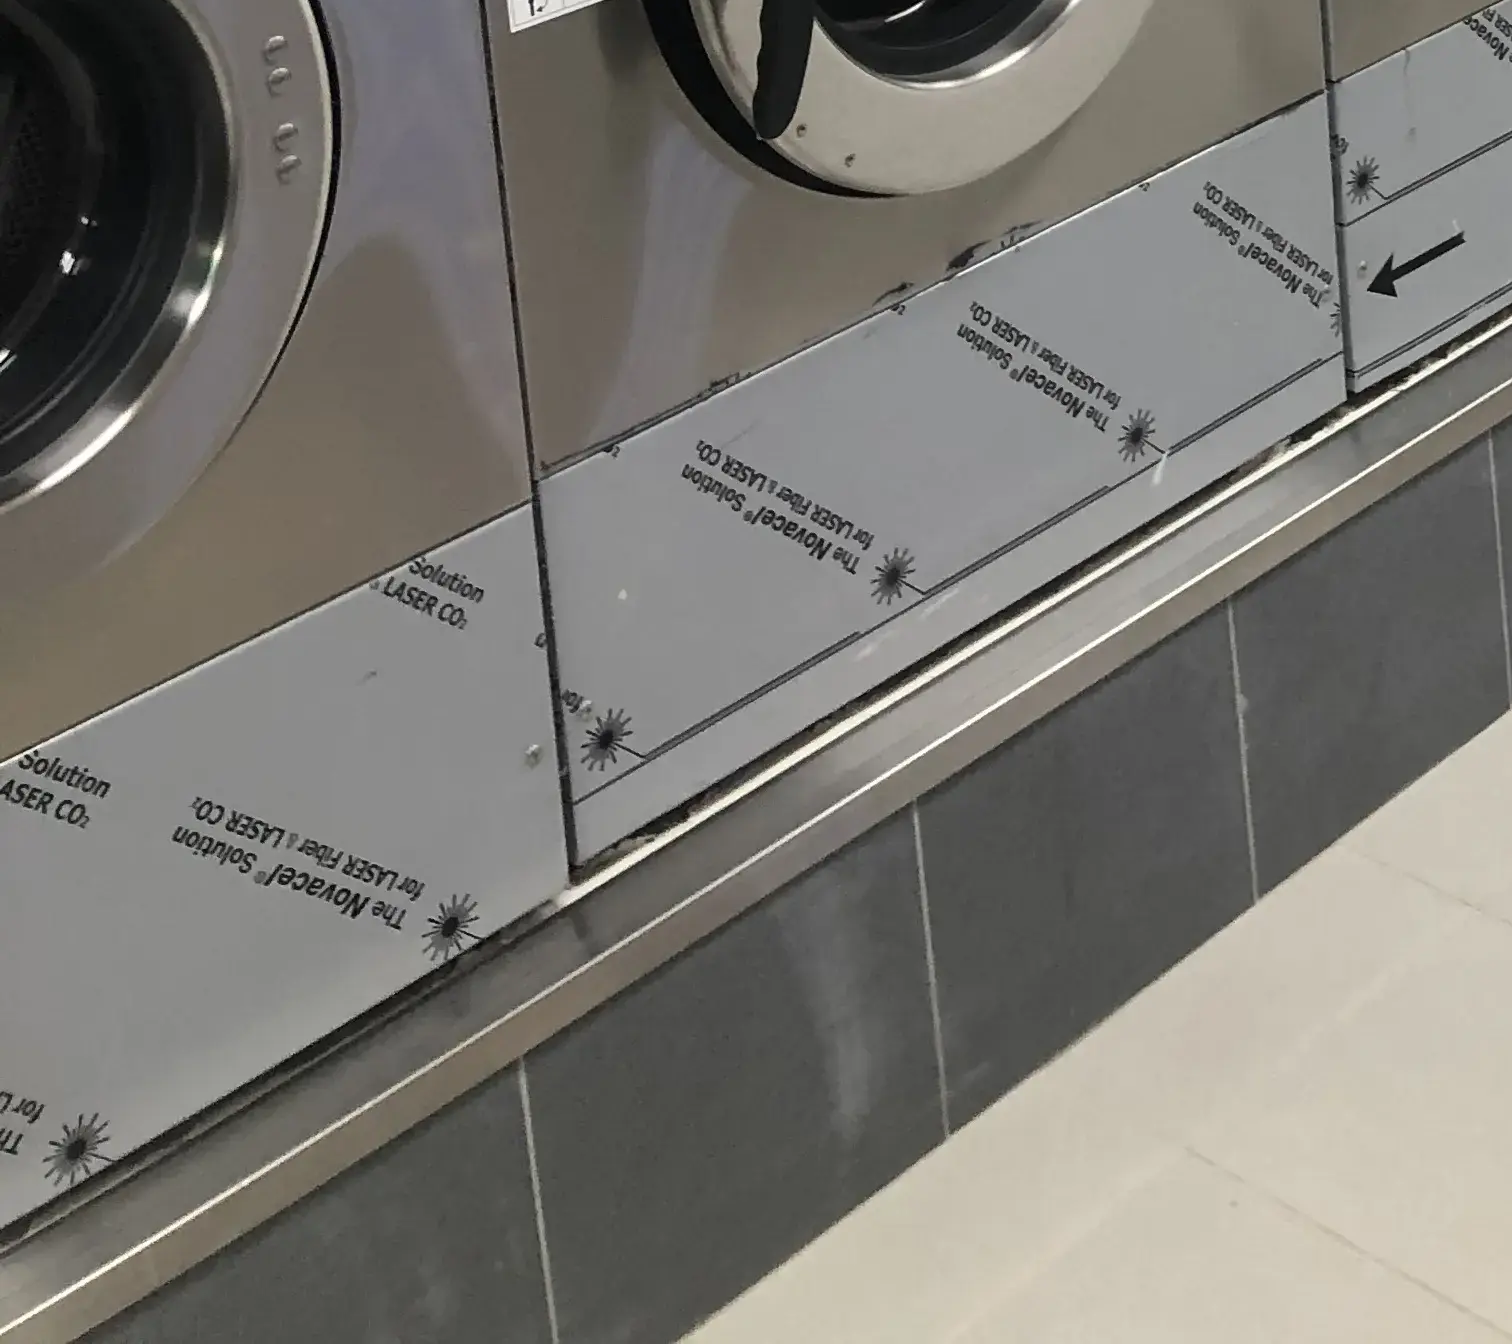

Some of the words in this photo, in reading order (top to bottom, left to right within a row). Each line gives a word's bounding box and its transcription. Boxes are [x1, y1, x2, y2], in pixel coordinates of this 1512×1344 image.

[1193, 201, 1240, 245] Solution
[1222, 196, 1256, 229] LASER
[1287, 244, 1319, 276] LASER
[957, 323, 1013, 369] Solution
[991, 316, 1031, 352] LASER
[1067, 365, 1105, 399] LASER
[1103, 389, 1122, 410] for
[1086, 406, 1110, 433] The
[681, 464, 746, 512] Solution
[721, 455, 767, 492] LASER
[810, 505, 854, 539] LASER
[853, 529, 874, 550] for
[832, 547, 860, 575] The
[382, 576, 438, 617] LASER
[409, 557, 484, 603] Solution
[18, 750, 111, 799] Solution
[225, 810, 285, 848] LASER
[171, 826, 257, 873] Solution
[297, 838, 343, 869] Fiber
[342, 855, 398, 891] LASER
[398, 876, 425, 901] for
[372, 901, 406, 930] The
[12, 1099, 44, 1124] for
